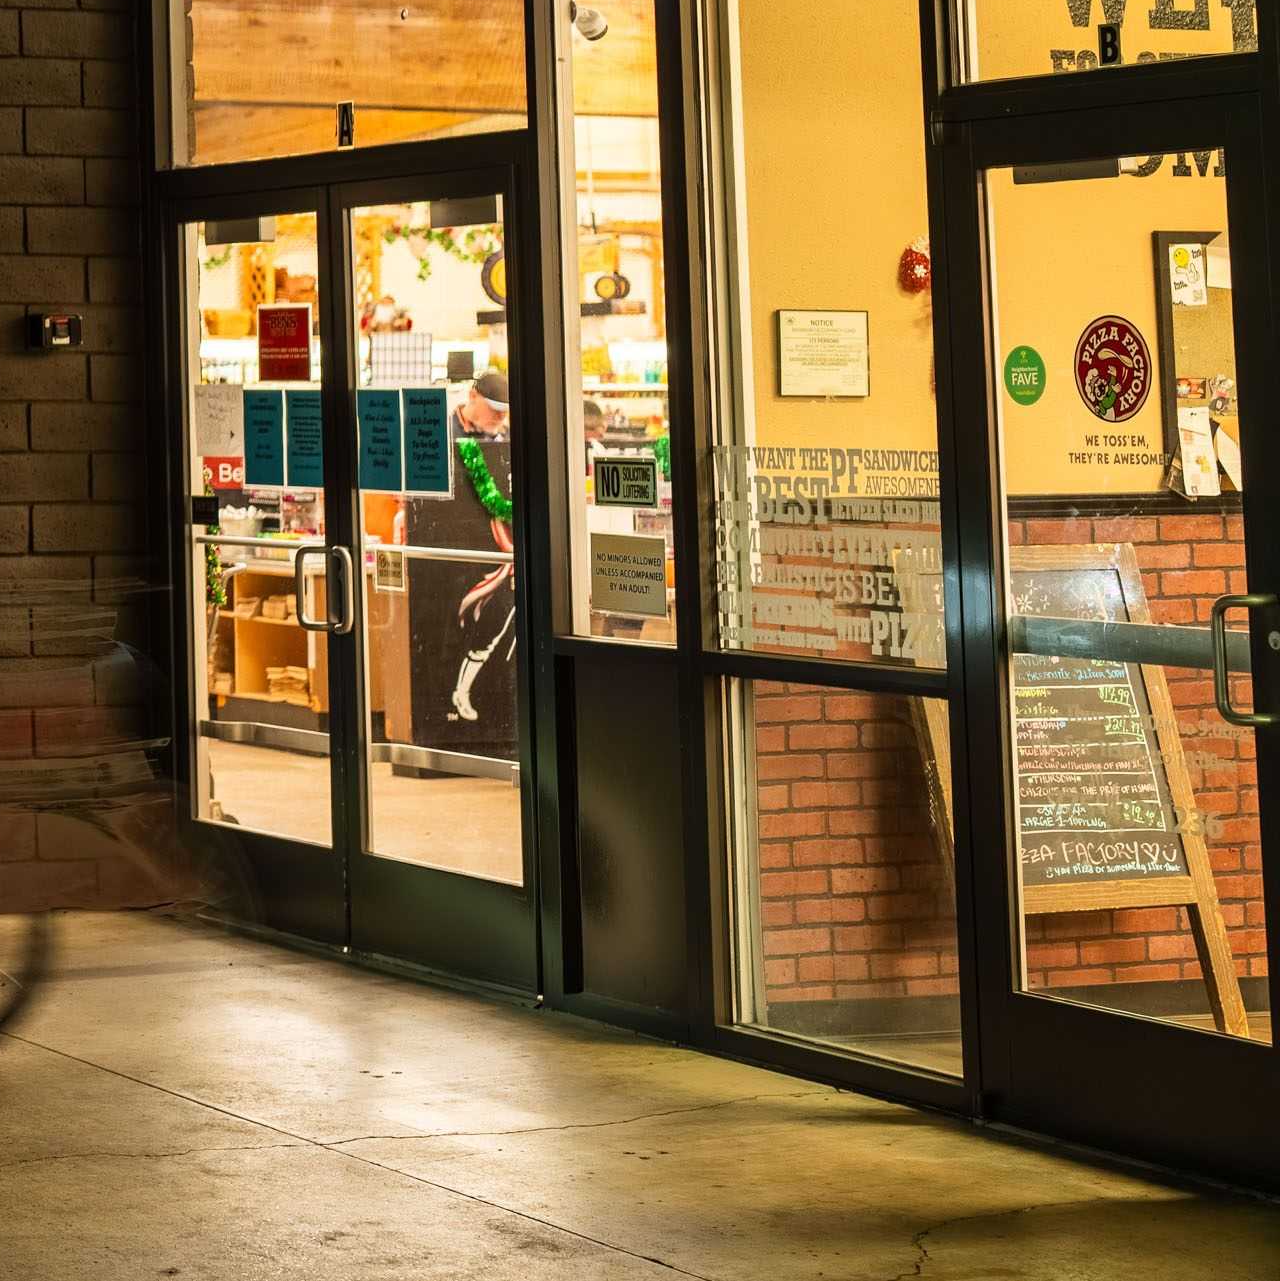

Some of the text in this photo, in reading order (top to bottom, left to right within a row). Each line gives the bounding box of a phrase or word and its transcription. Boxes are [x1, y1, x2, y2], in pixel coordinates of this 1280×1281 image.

[1099, 24, 1120, 64] B
[811, 319, 834, 327] NOTICE
[1082, 327, 1145, 412] PIZZA FACTORY
[1011, 372, 1039, 386] FAVE
[1085, 435, 1149, 449] WE TOSS'EM,
[1068, 452, 1109, 465] THEY'RE
[753, 447, 798, 470] WANT
[799, 448, 829, 471] THE
[830, 448, 862, 494] PF
[863, 450, 940, 473] SANDWICH
[601, 466, 650, 498] NO SOLICITING
[623, 483, 650, 499] LOITERING
[754, 475, 830, 524] BEST
[596, 552, 662, 567] NO MINORS ALLOWED
[596, 567, 663, 582] UNLESS ACCOMPANIED
[609, 582, 650, 594] BY AN ADULT!
[1080, 786, 1097, 795] THE
[1061, 841, 1140, 866] FACTORY
